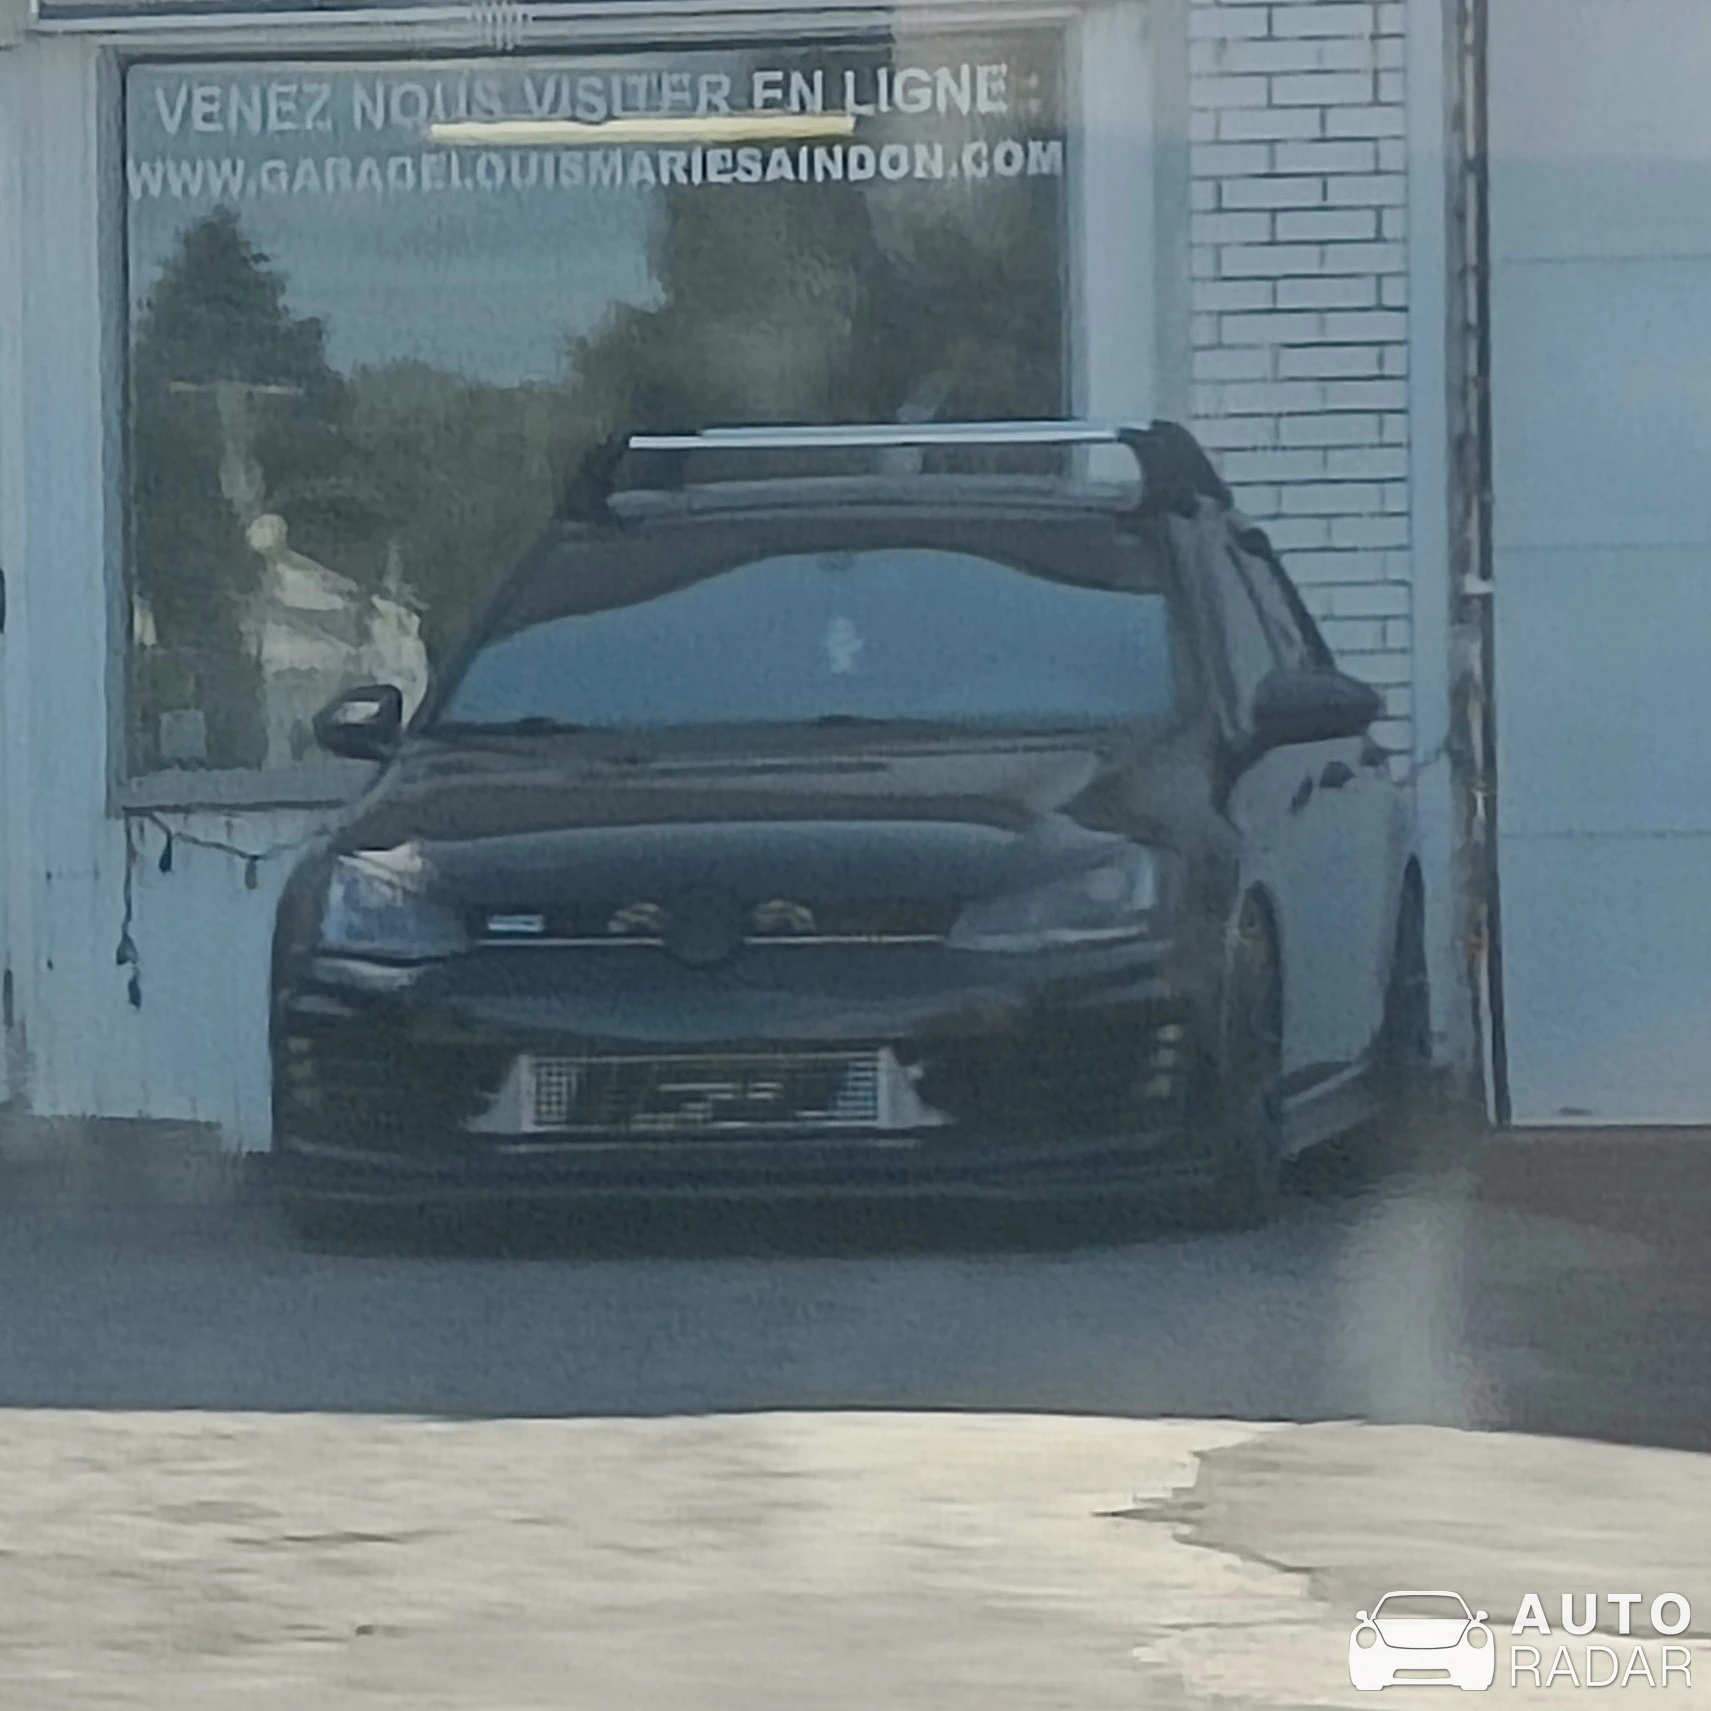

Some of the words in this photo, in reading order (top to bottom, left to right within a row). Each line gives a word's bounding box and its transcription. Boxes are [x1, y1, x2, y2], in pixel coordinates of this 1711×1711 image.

[155, 80, 333, 136] VENEZ
[353, 77, 503, 132] NOUS
[524, 73, 731, 123] VISITER
[752, 68, 824, 114] EN
